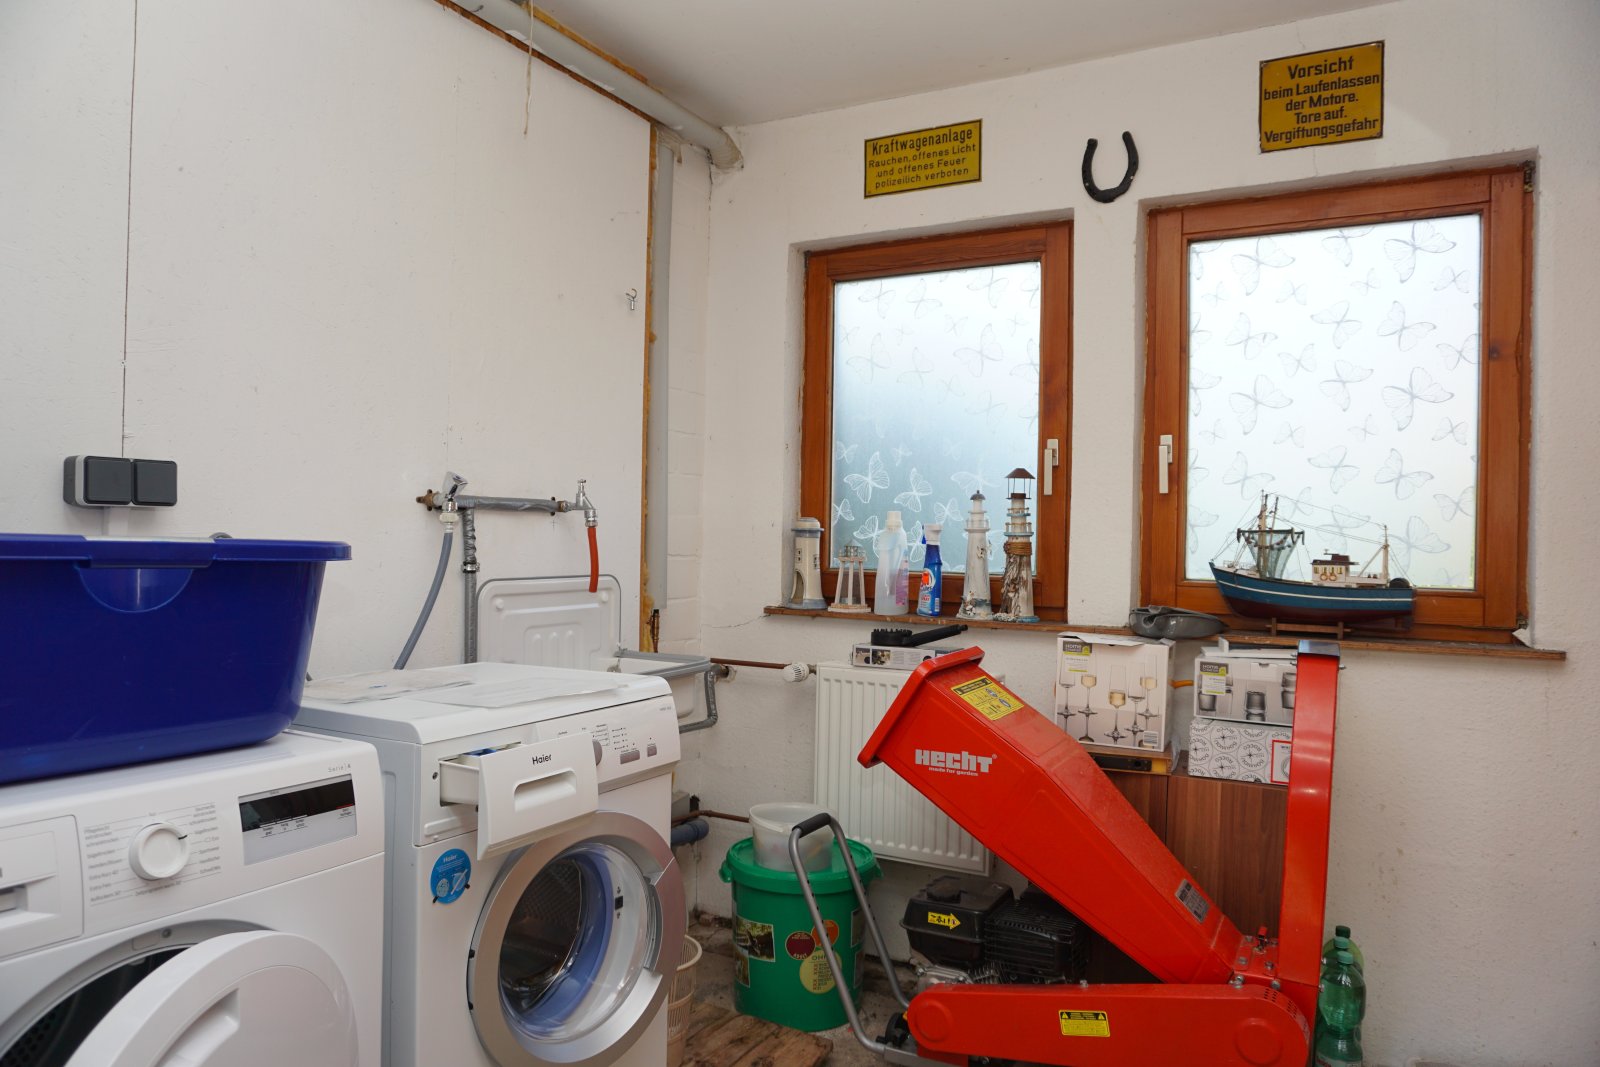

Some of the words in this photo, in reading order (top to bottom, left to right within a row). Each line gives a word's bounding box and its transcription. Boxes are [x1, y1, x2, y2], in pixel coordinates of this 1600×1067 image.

[1288, 56, 1354, 79] Vorsicht
[1264, 87, 1293, 100] beim
[1296, 74, 1380, 95] Laufenlassen
[1285, 99, 1307, 111] der
[1309, 93, 1358, 108] Motore.
[1294, 112, 1321, 124] Tore
[1324, 106, 1347, 120] auf.
[1264, 118, 1379, 143] Vergiftungsgefahr
[872, 128, 973, 156] Kraftwagenanlage
[912, 148, 949, 160] offenes
[952, 144, 976, 155] Licht
[877, 168, 894, 178] und
[897, 162, 934, 174] offenes
[937, 157, 967, 167] Feuer
[875, 175, 921, 189] polizeilich
[925, 168, 969, 180] verboten
[532, 754, 552, 765] Haier
